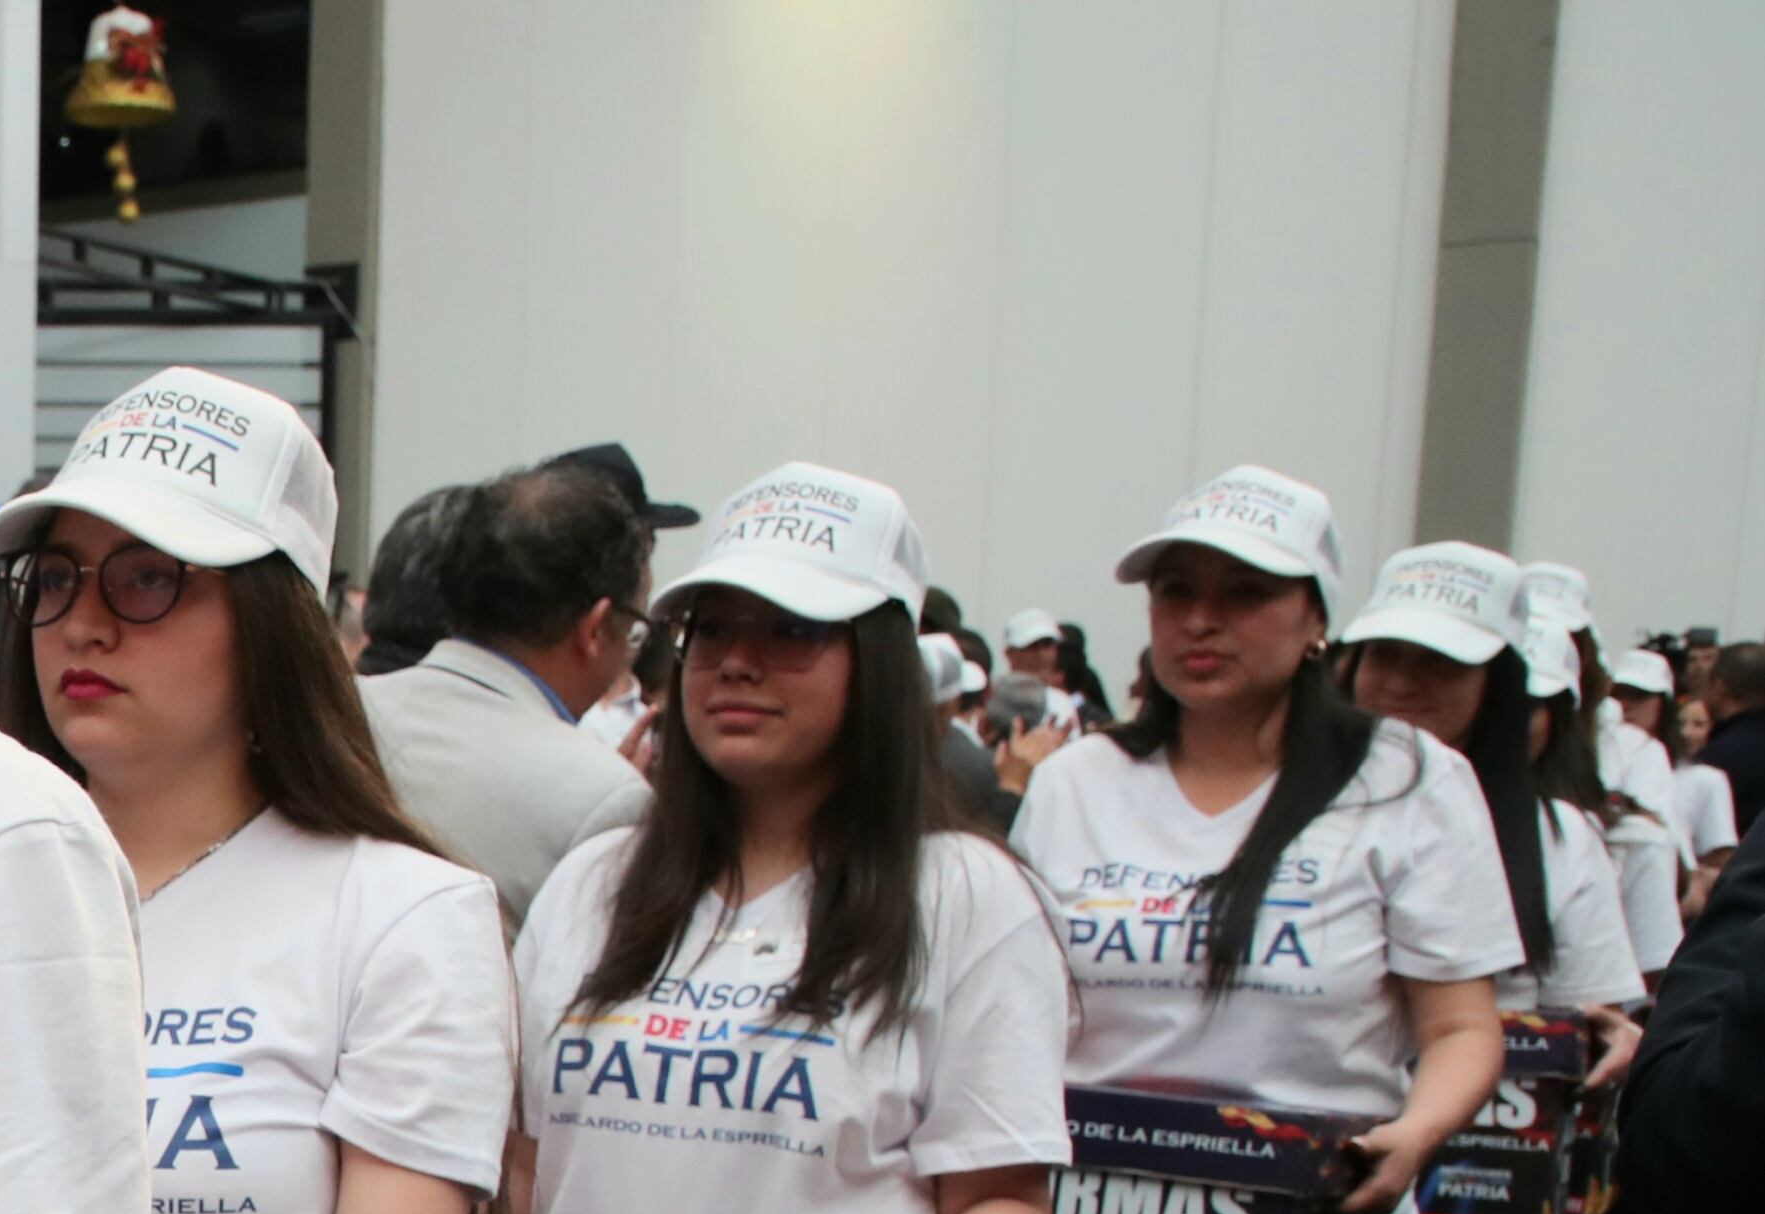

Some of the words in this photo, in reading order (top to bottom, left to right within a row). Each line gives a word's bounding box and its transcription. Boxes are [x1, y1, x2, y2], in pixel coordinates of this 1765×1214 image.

[89, 390, 251, 437] FENSORES
[120, 411, 148, 428] DE
[151, 412, 176, 431] LA
[778, 501, 800, 513] LA
[1171, 504, 1277, 533] ATRIA
[1386, 583, 1479, 615] PATRIA
[1140, 897, 1179, 915] DE
[1068, 918, 1311, 967] PATRA
[644, 1014, 690, 1040] DE
[698, 1019, 730, 1042] LA
[553, 1038, 819, 1122] PATRIA
[647, 1124, 674, 1139] DE
[679, 1127, 706, 1140] LA
[712, 1128, 824, 1157] ESPRIELLA
[1084, 1121, 1115, 1140] DE
[1117, 1126, 1147, 1144] LA
[1152, 1128, 1276, 1159] ESPRIELLA
[152, 1197, 257, 1214] RIELLA
